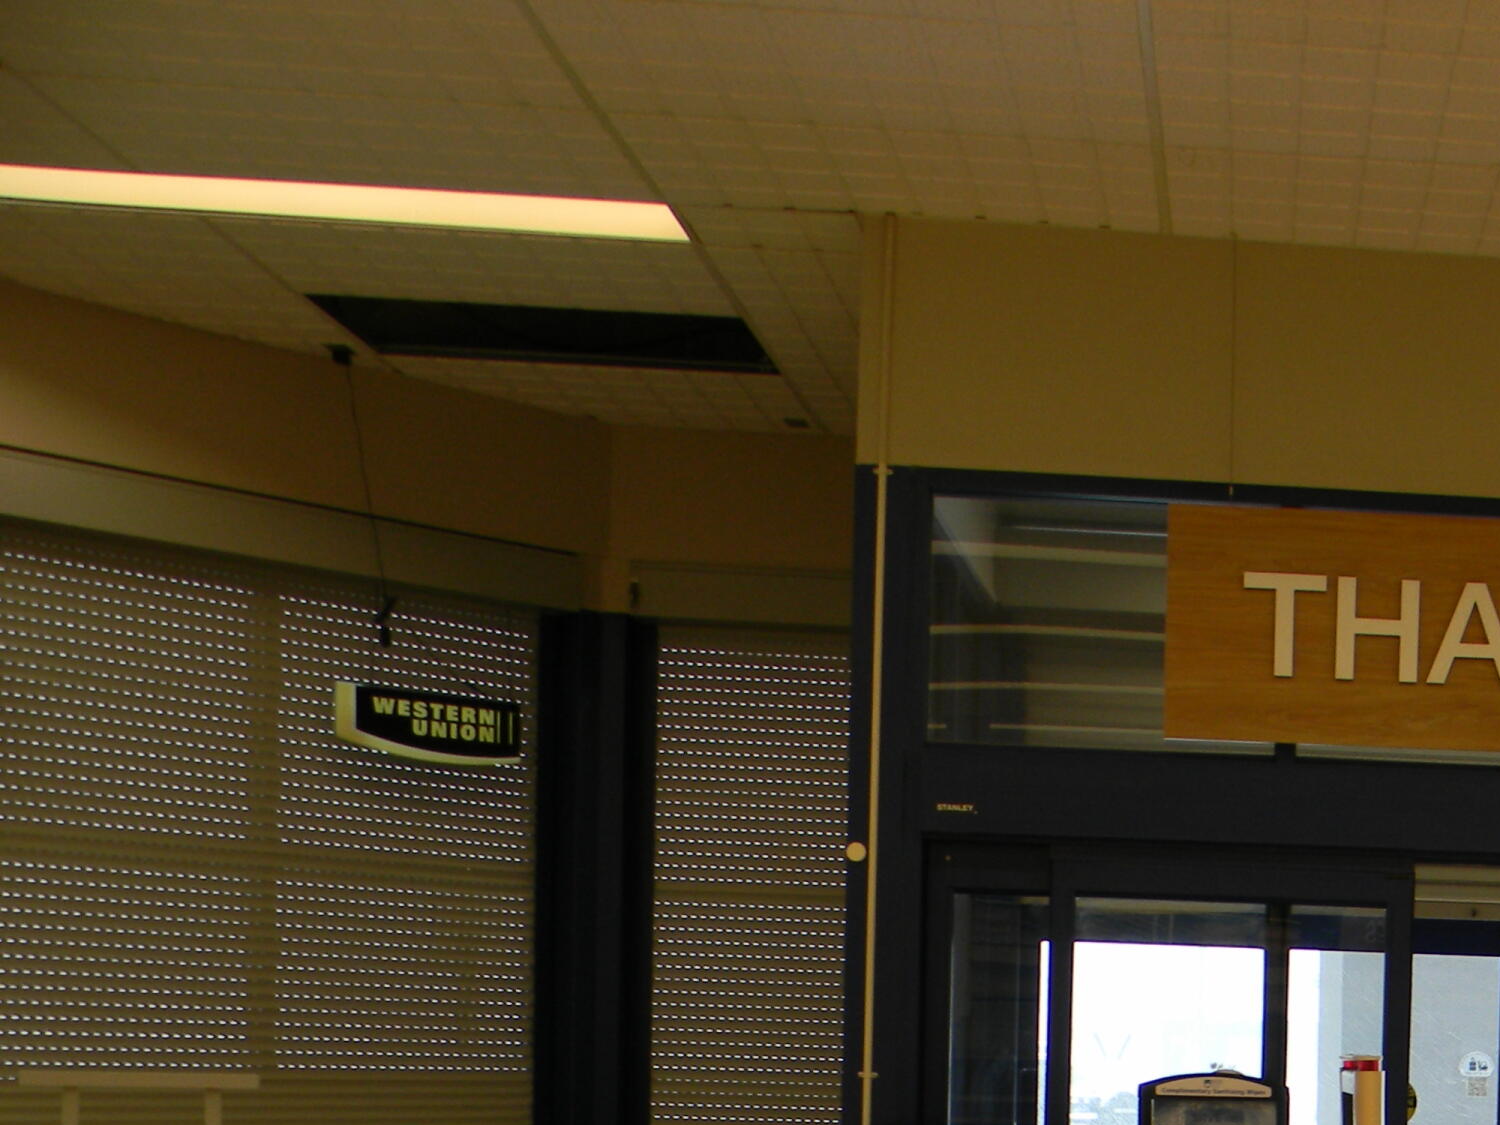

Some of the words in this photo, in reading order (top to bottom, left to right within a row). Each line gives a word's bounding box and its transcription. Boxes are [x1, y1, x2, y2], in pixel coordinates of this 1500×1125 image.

[371, 696, 496, 726] WESTERN
[412, 718, 496, 745] UNION
[936, 803, 974, 812] STANLEY
